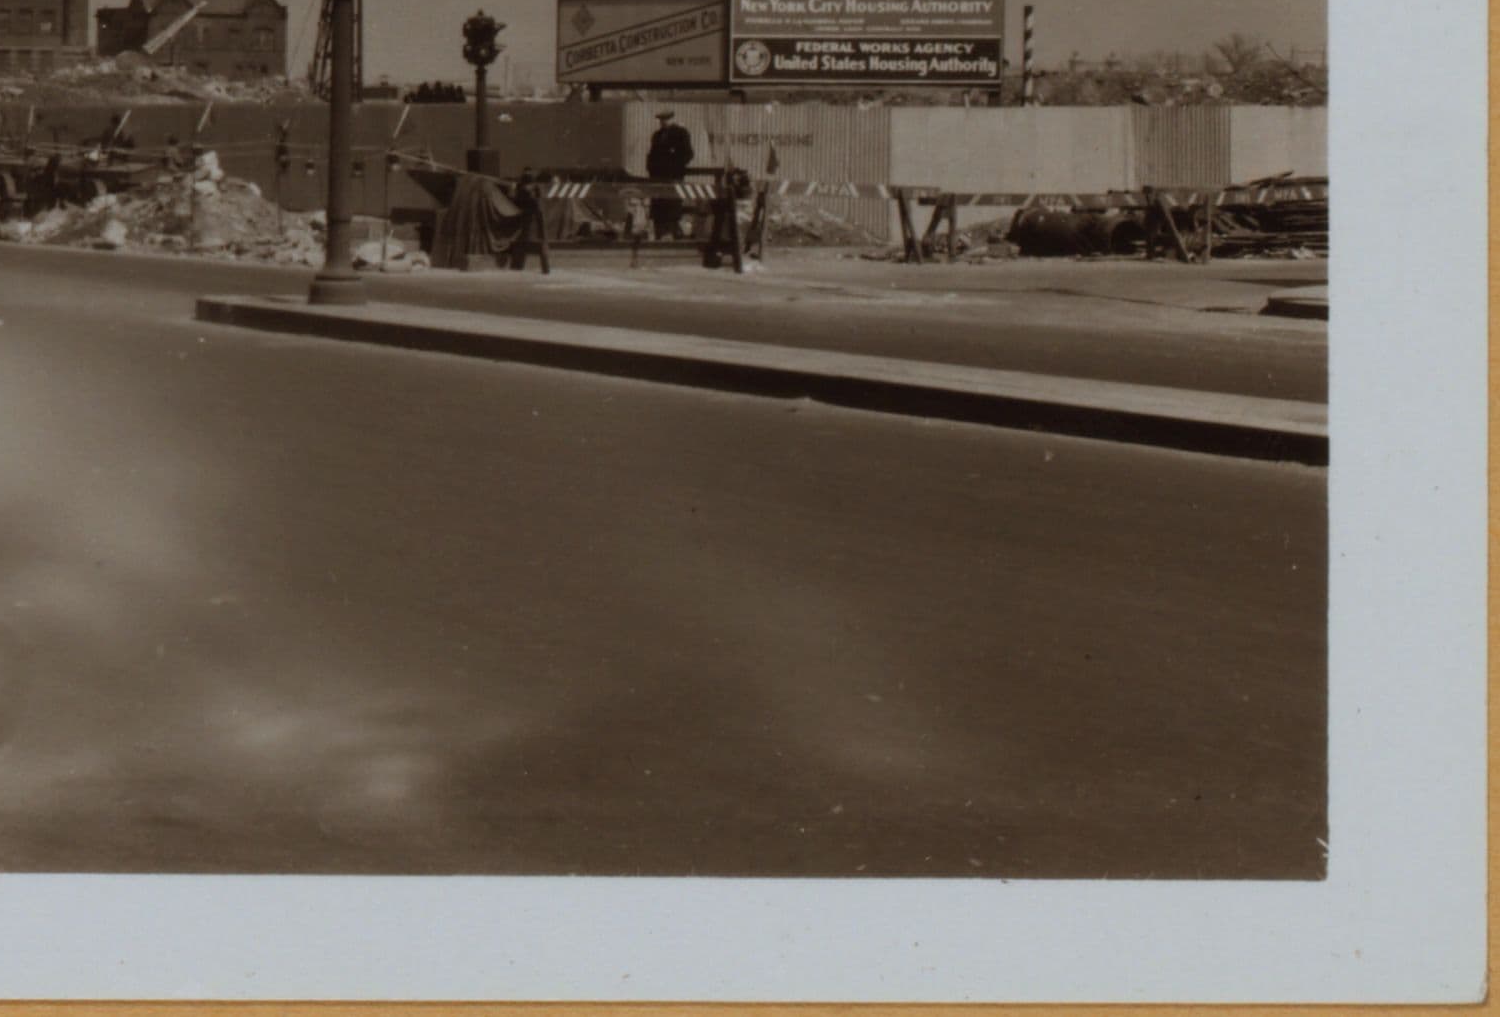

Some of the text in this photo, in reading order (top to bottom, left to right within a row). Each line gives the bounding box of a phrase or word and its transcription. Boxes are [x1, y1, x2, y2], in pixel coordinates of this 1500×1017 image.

[796, 42, 974, 54] FEDERAL WORKS AGENCY
[774, 55, 997, 77] United States Housing Authority
